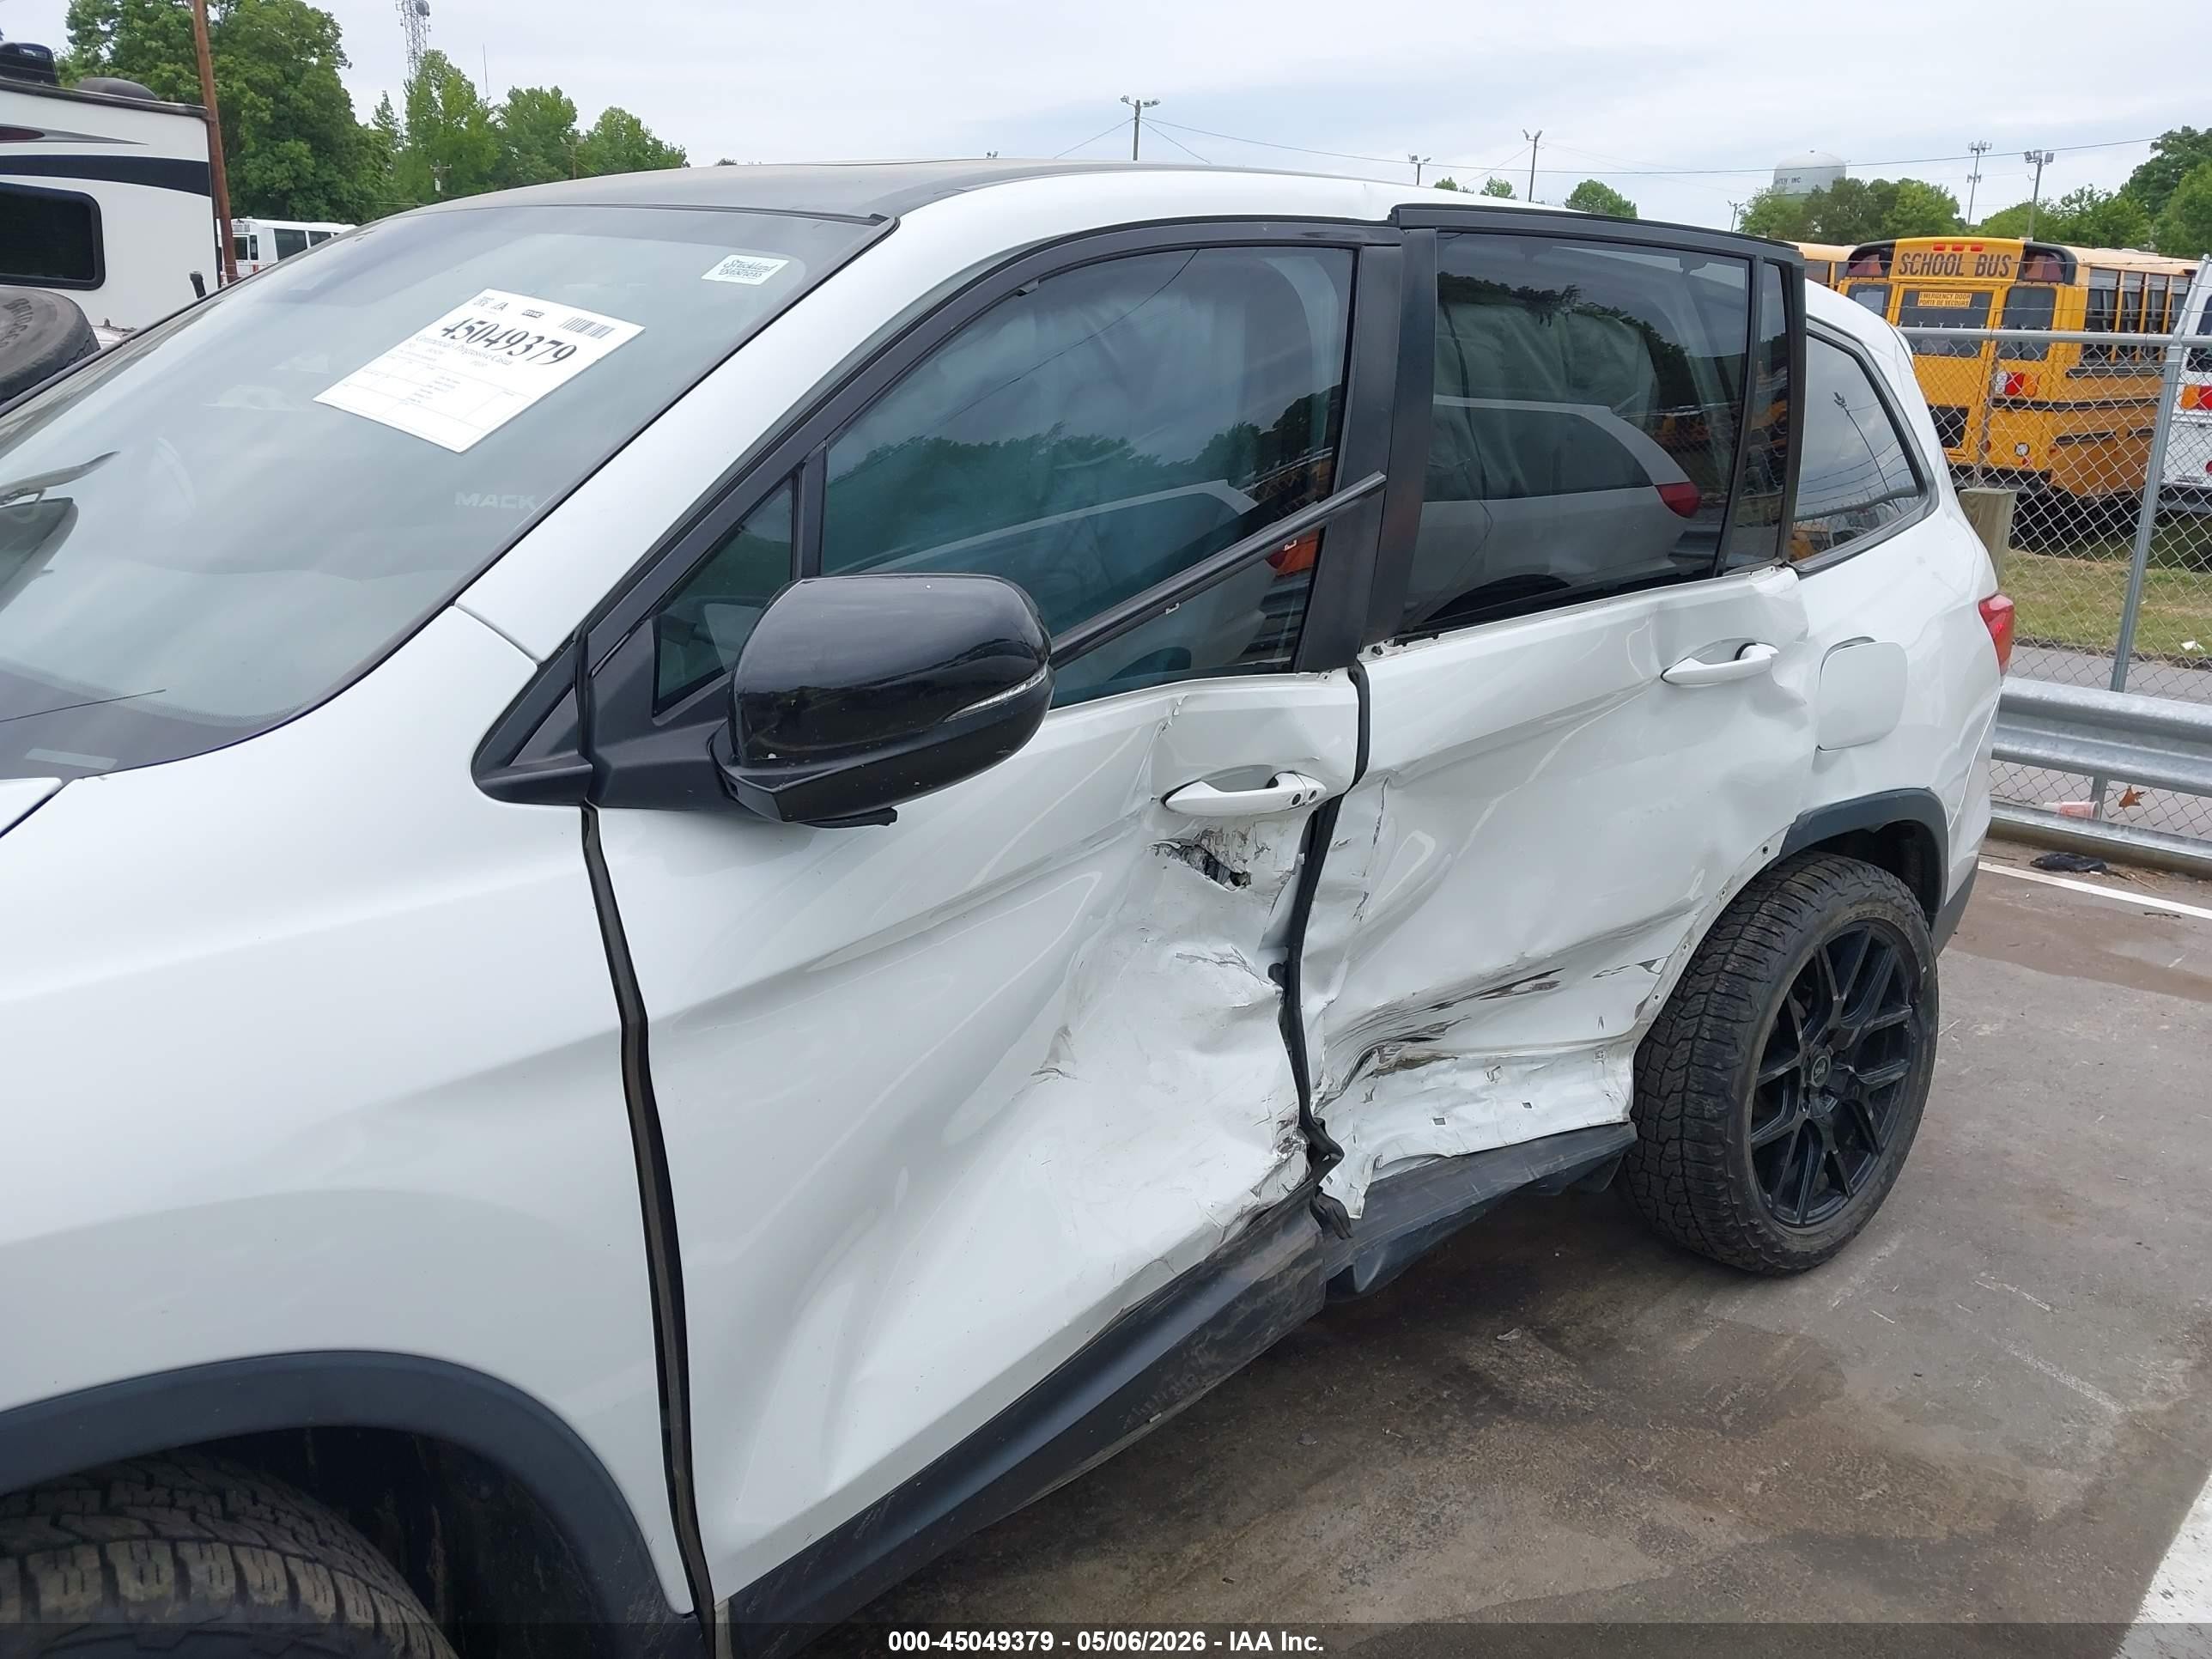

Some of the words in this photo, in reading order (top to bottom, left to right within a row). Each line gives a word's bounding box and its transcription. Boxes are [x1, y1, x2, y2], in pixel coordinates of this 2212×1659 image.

[1898, 252, 1965, 276] SCHOOL
[1974, 253, 2012, 277] BUS
[441, 318, 577, 365] 45049379
[454, 491, 537, 509] MACK
